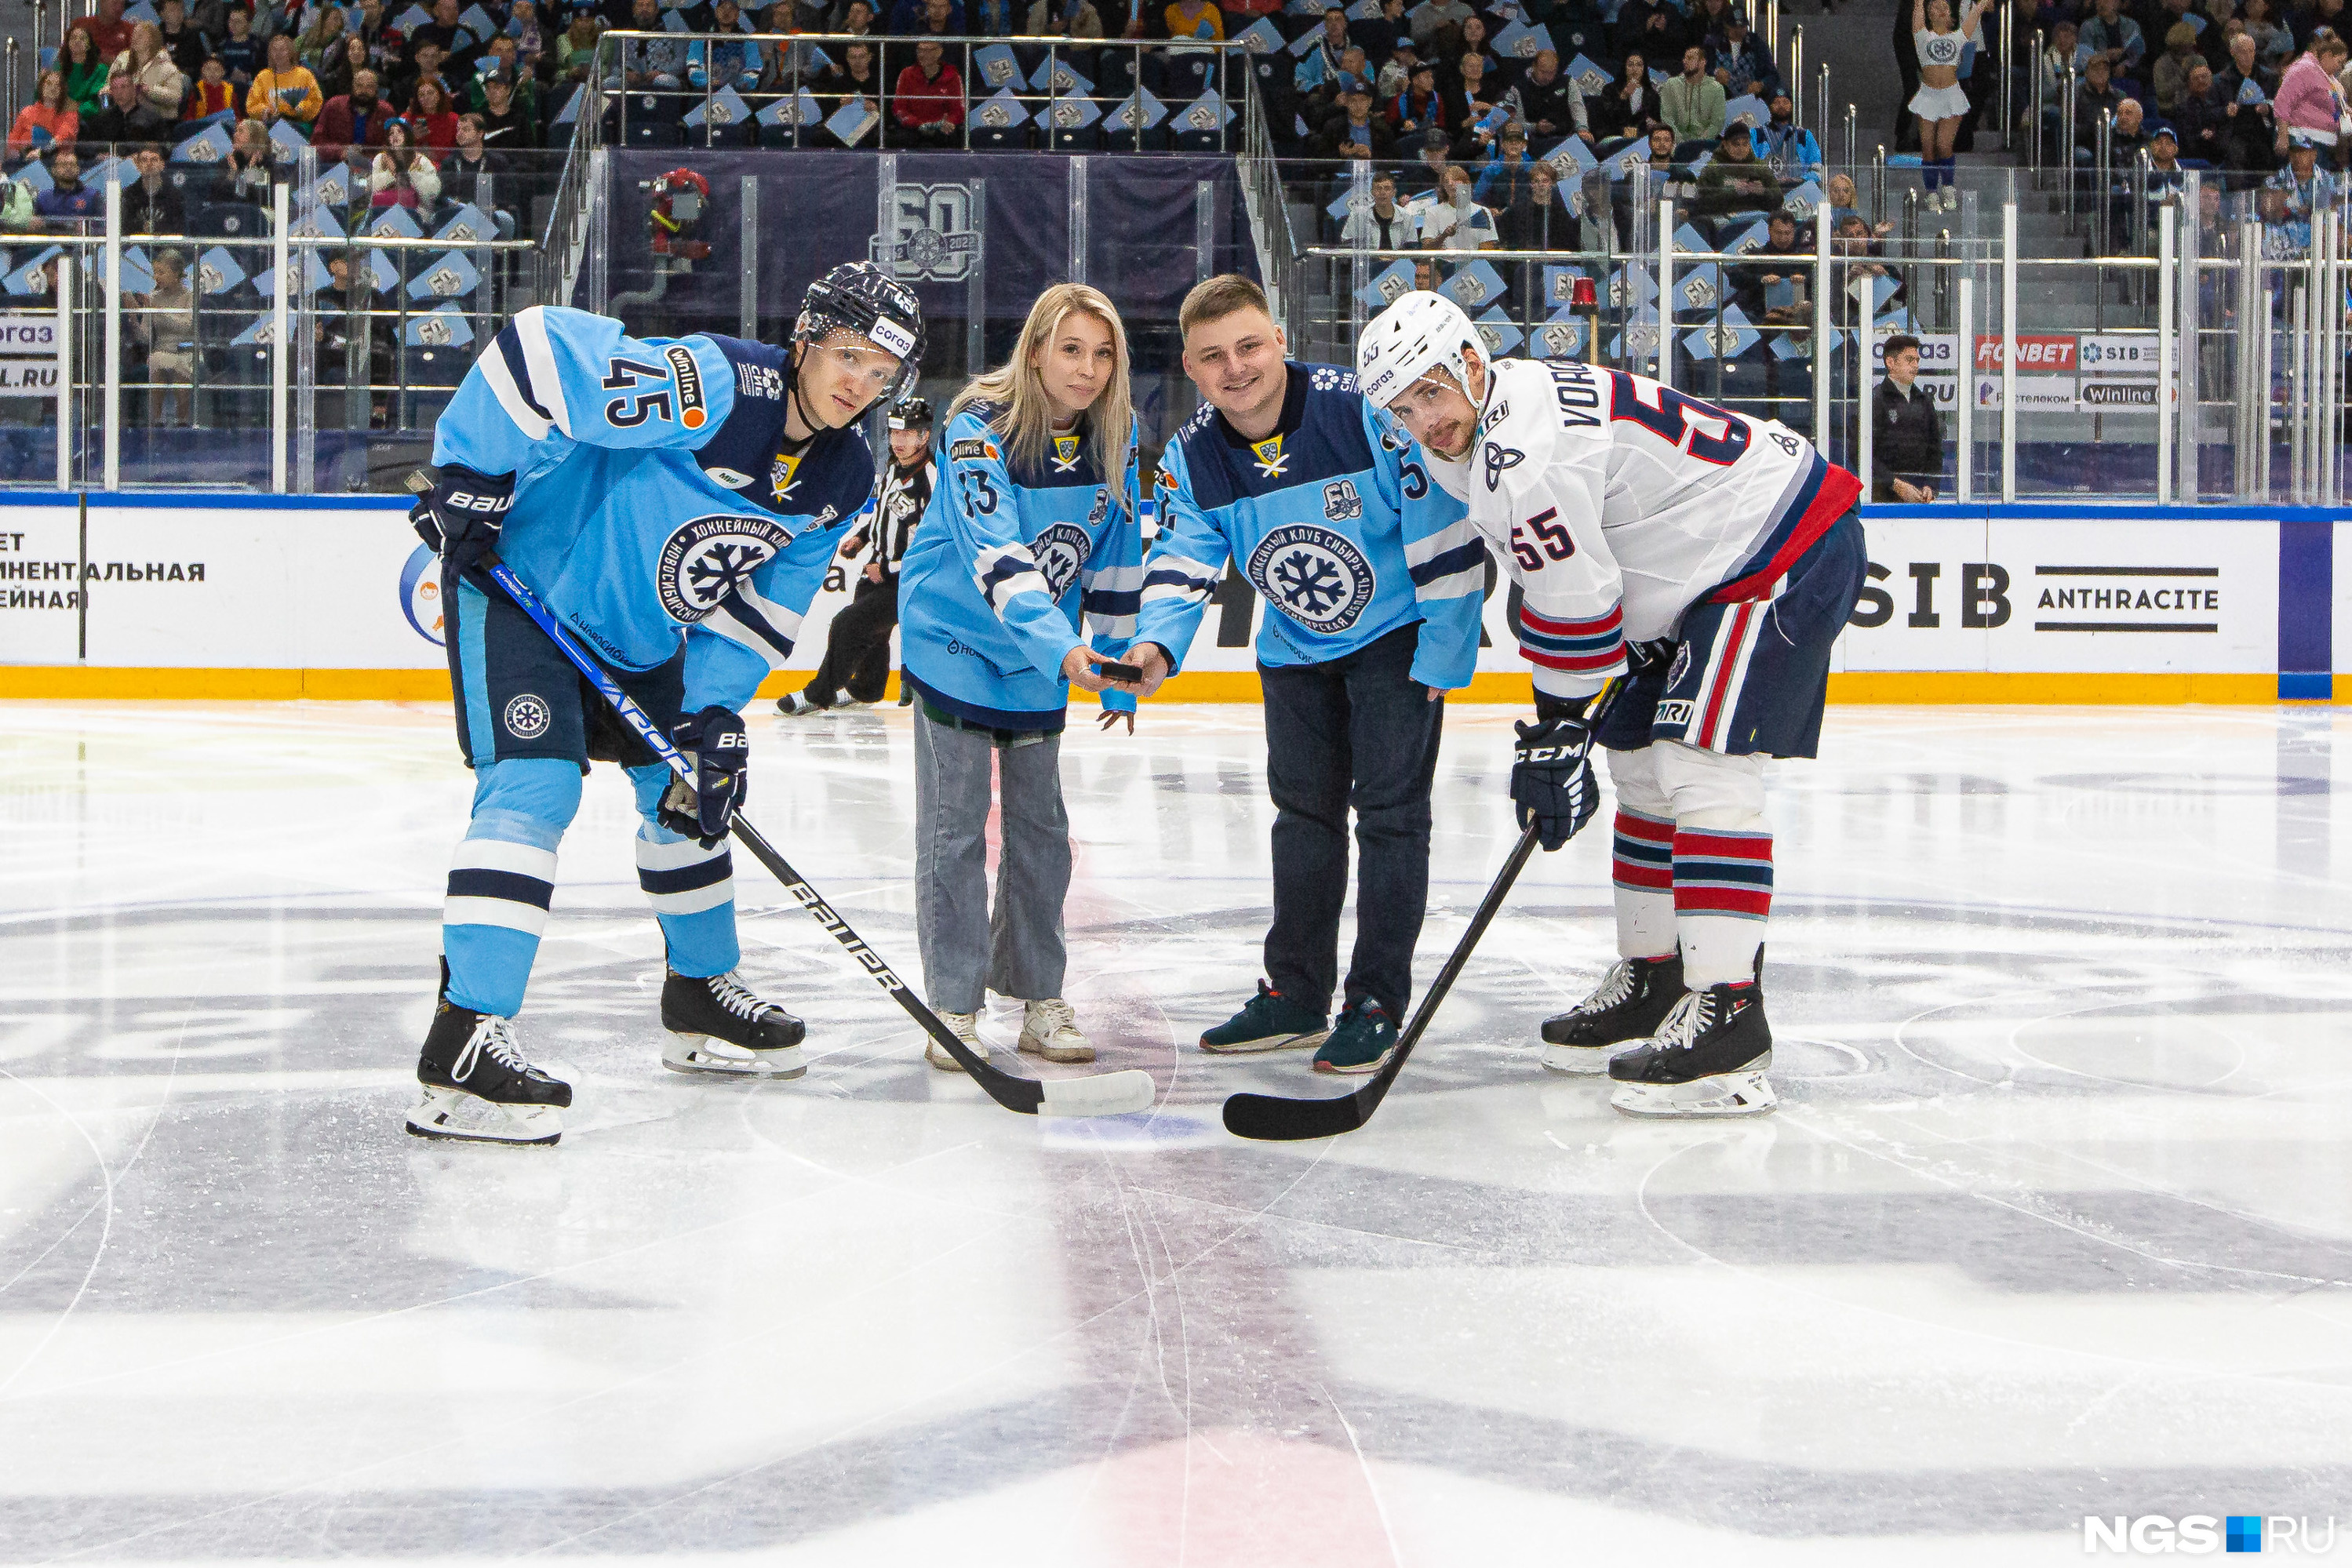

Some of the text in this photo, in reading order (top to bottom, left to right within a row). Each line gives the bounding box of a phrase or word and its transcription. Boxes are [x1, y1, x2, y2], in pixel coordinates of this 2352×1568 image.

[876, 325, 911, 351] согаз
[2106, 347, 2139, 361] SIB
[601, 357, 675, 430] 45
[670, 349, 695, 405] Winline
[751, 365, 763, 397] СИБ
[1366, 369, 1394, 396] согаз
[2089, 387, 2152, 403] Winline
[1611, 367, 1752, 467] 55
[958, 470, 999, 519] 13
[690, 519, 771, 540] ХОККЕЙНЫЙ
[1510, 506, 1575, 572] 55
[1251, 529, 1360, 582] ХОККЕЙНЫЙ КЛУБ СИБИРЬ
[1262, 577, 1371, 632] НОВОСИБИРСКАЯ ОБЛАСТЬ
[1846, 562, 2219, 629] SIB ANTHRACITE
[1515, 742, 1583, 763] CCM
